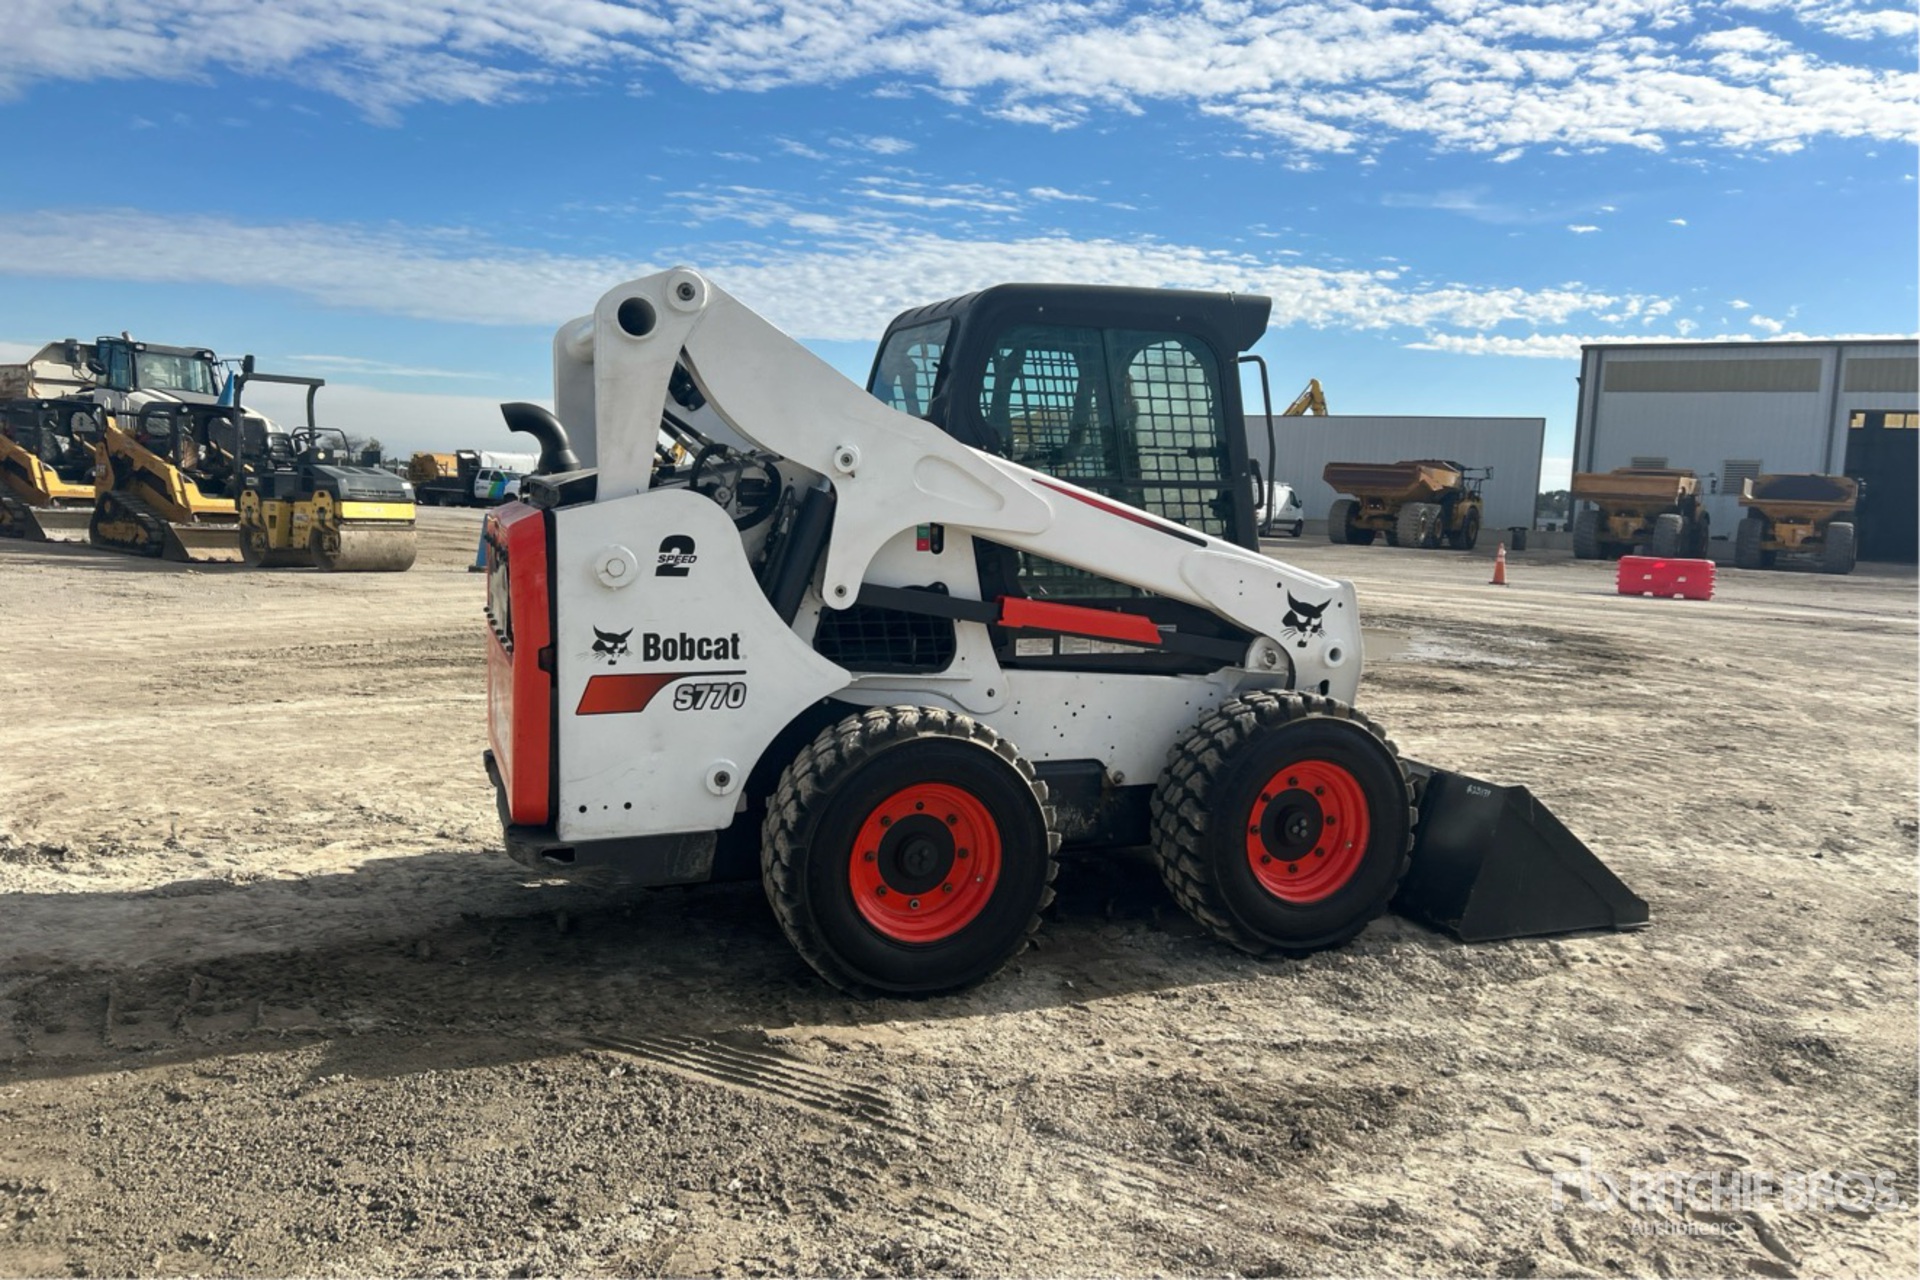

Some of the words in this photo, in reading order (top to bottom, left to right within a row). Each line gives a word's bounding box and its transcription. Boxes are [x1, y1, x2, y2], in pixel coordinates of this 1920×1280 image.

[655, 534, 696, 577] 2
[657, 554, 698, 564] SPEED
[643, 632, 740, 662] Bobcat
[673, 682, 747, 711] S770
